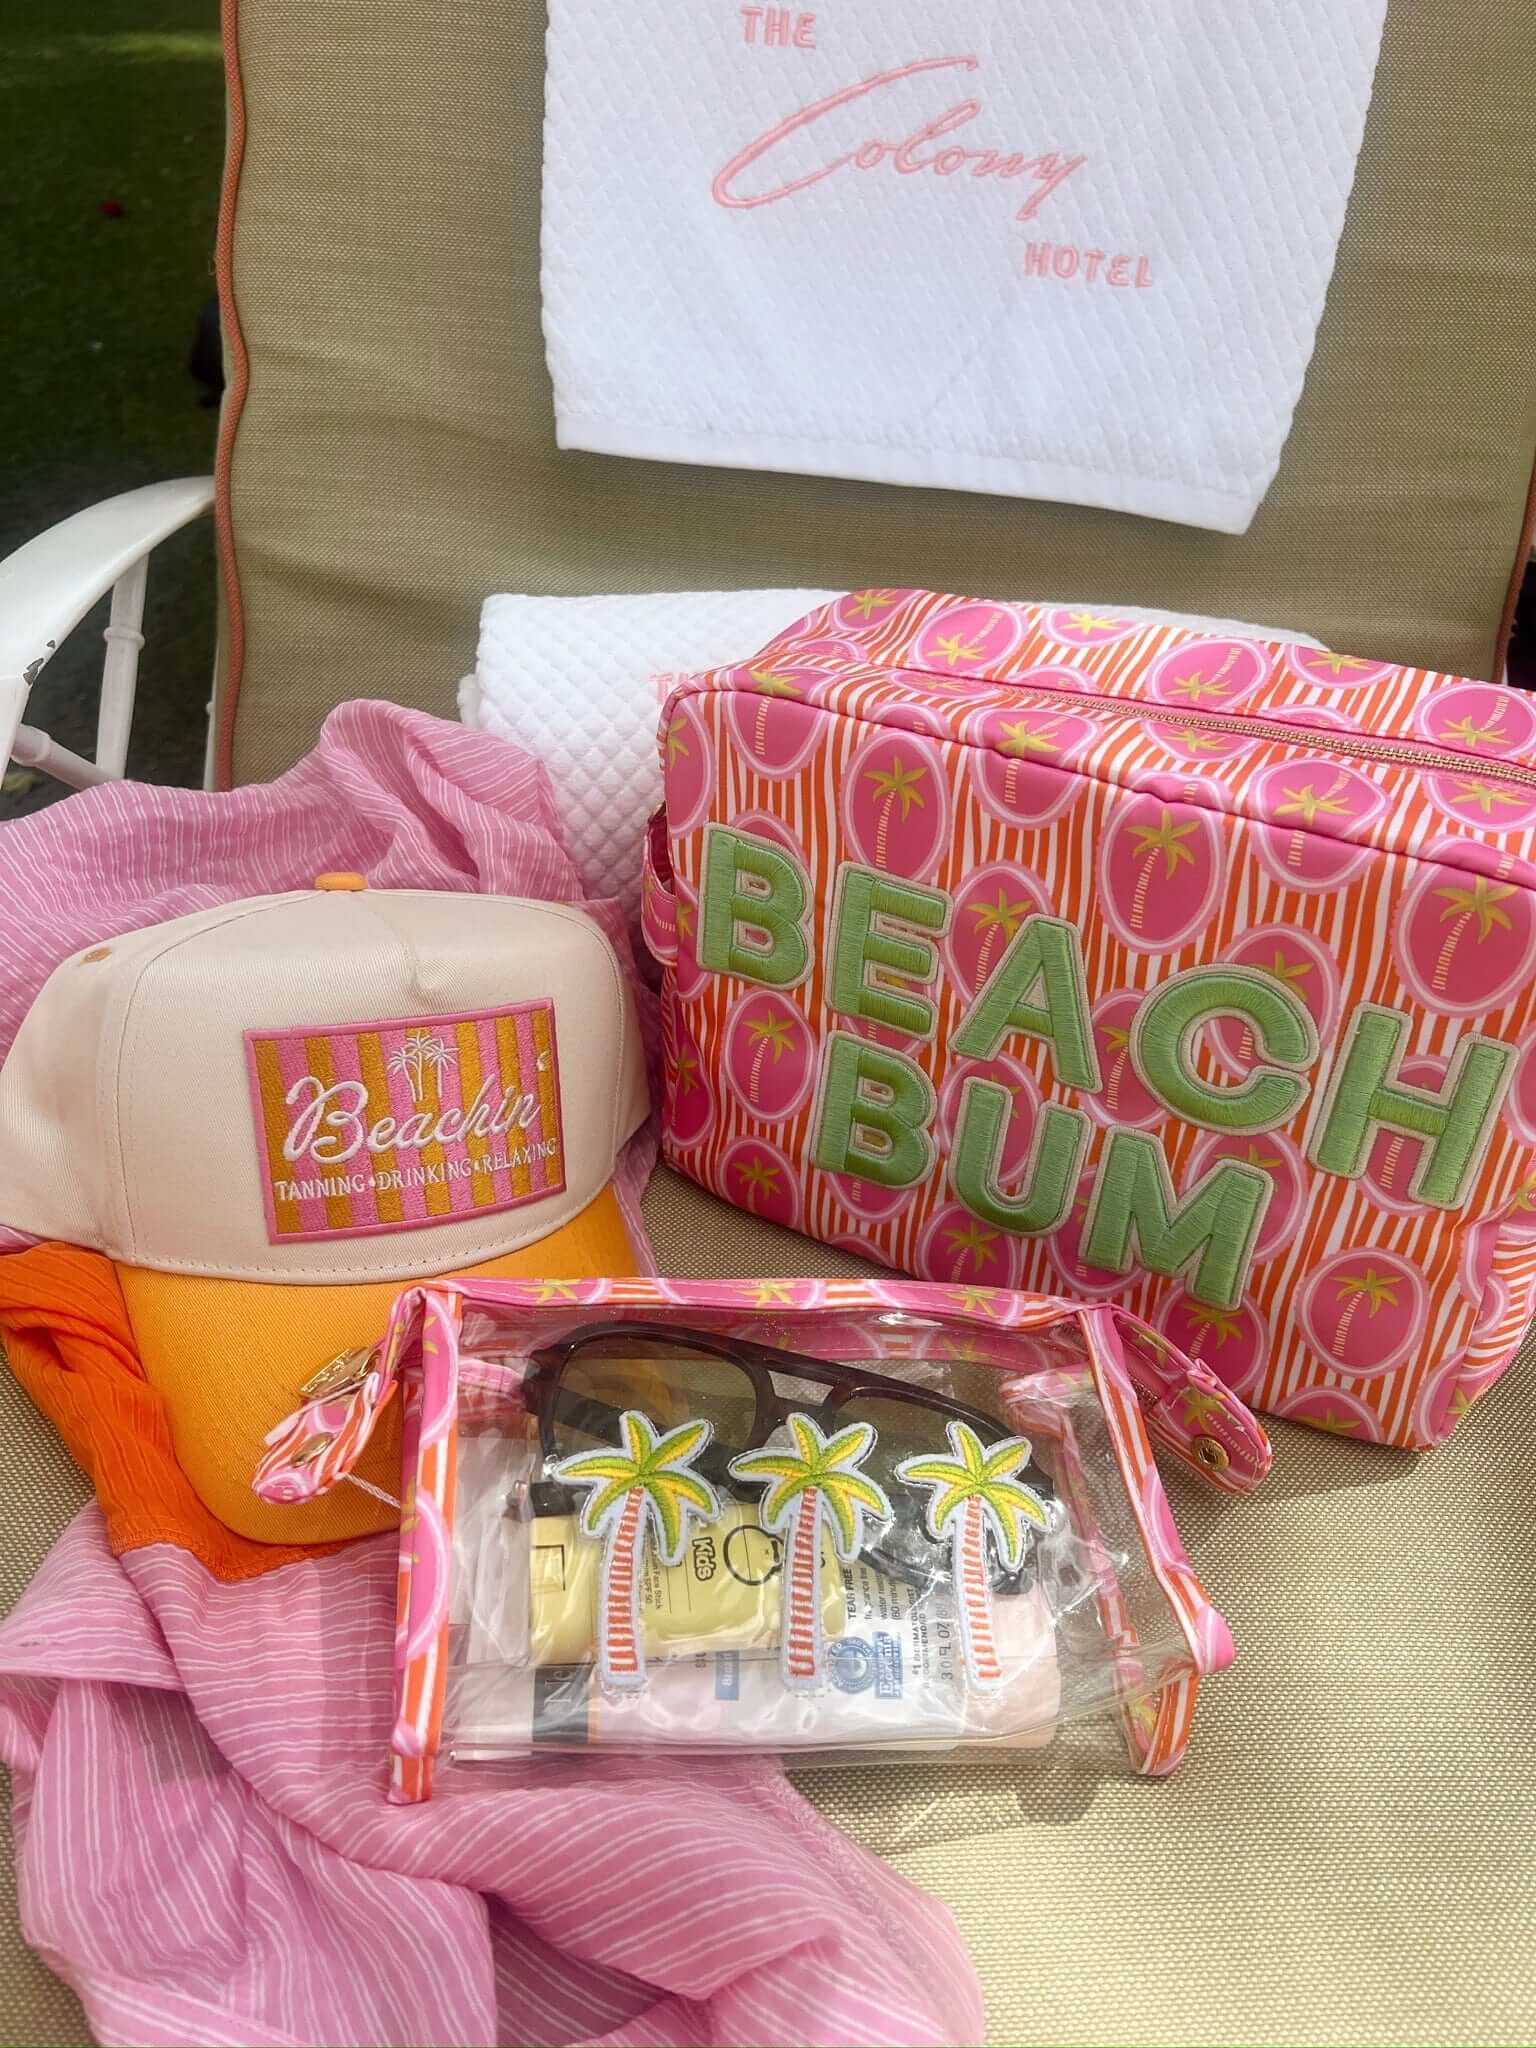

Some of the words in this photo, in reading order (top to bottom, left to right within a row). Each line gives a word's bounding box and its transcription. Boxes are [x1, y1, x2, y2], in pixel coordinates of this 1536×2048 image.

[741, 6, 817, 49] THE
[712, 55, 1087, 221] Colony
[1023, 241, 1154, 289] HOTEL
[697, 821, 1519, 1211] BEACH
[275, 1173, 367, 1202] TANNING
[377, 1157, 473, 1192] DRINKING
[482, 1137, 558, 1174] RELAXING
[810, 1030, 1275, 1311] BUM
[692, 1536, 716, 1581] Kids
